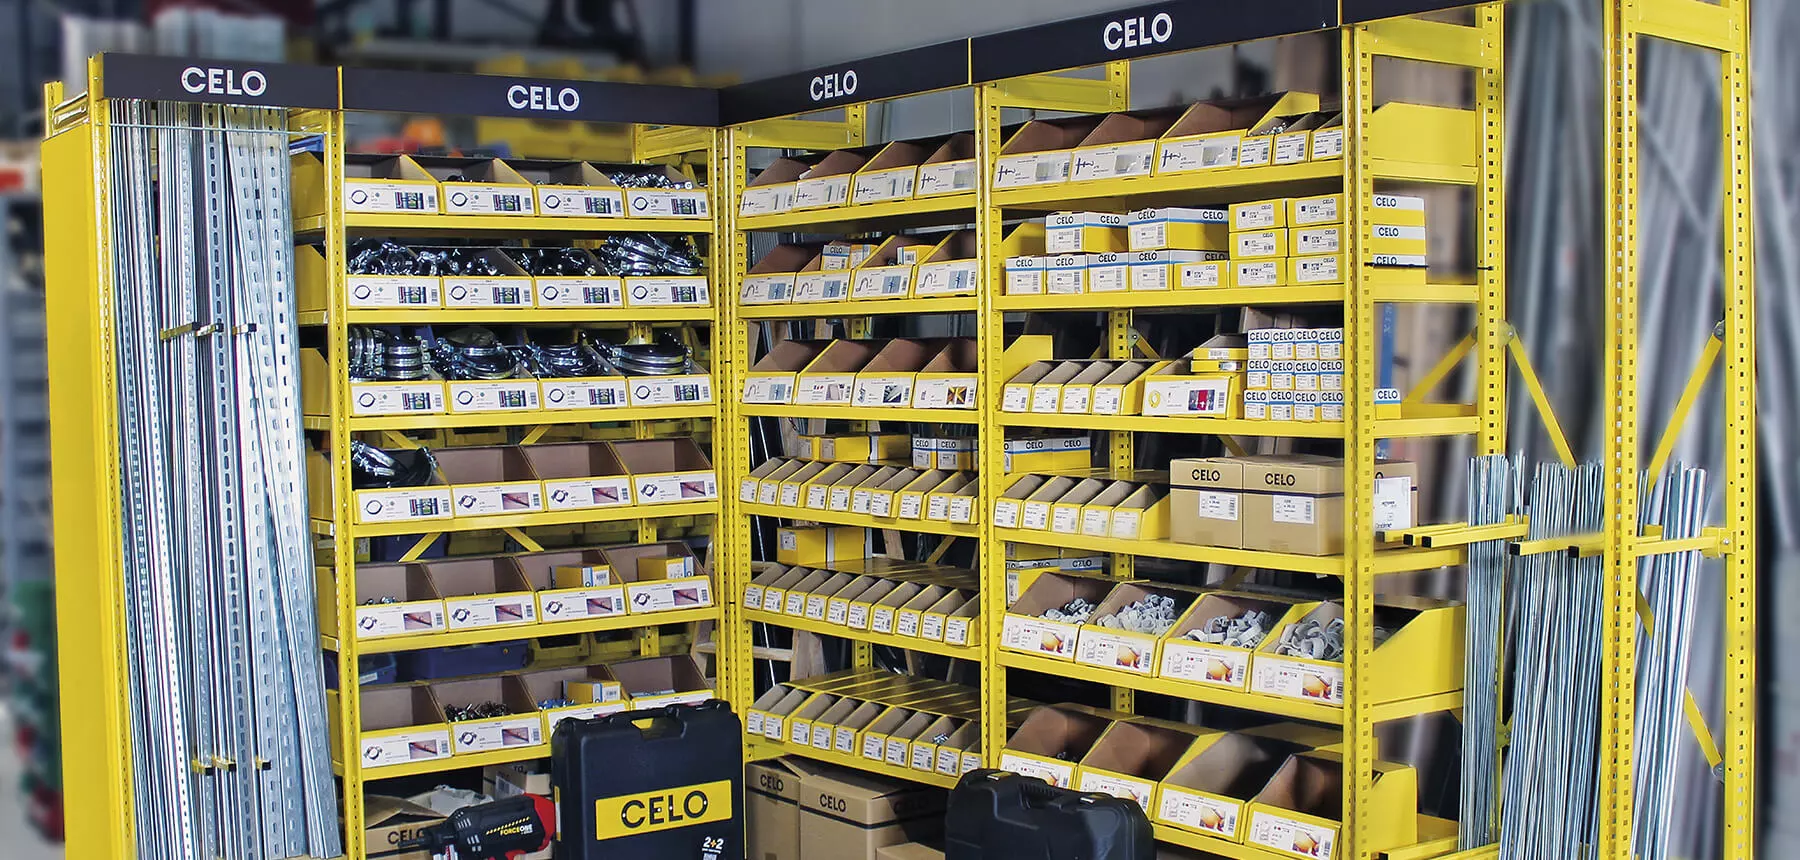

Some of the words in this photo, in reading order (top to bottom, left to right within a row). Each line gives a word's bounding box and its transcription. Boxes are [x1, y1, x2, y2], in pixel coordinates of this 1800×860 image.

[1103, 12, 1173, 51] CELO
[181, 66, 267, 97] CELO
[810, 70, 858, 101] CELO
[507, 84, 580, 112] CELO
[1376, 197, 1397, 207] CELO
[1137, 210, 1156, 220] CELO
[1202, 211, 1224, 220] CELO
[1056, 216, 1074, 225] CELO
[1100, 215, 1120, 225] CELO
[1379, 227, 1399, 237] CELO
[1098, 254, 1117, 262] CELO
[1138, 252, 1158, 261] CELO
[1205, 253, 1226, 261] CELO
[1376, 256, 1397, 265] CELO
[1015, 259, 1033, 268] CELO
[1055, 258, 1074, 266] CELO
[1249, 332, 1270, 341] CELO
[1273, 332, 1294, 341] CELO
[1296, 330, 1318, 340] CELO
[1319, 330, 1341, 340] CELO
[1248, 360, 1269, 369] CELO
[1272, 362, 1293, 371] CELO
[1295, 362, 1317, 371] CELO
[1320, 361, 1342, 370] CELO
[1245, 392, 1267, 401] CELO
[1270, 391, 1292, 400] CELO
[1295, 393, 1317, 402] CELO
[1321, 392, 1343, 401] CELO
[1377, 390, 1398, 399] CELO
[915, 440, 929, 448] CELO
[941, 441, 956, 449] CELO
[1025, 440, 1044, 449] CELO
[1063, 440, 1082, 448] CELO
[1191, 469, 1221, 482] CELO
[1264, 473, 1296, 486] CELO
[1072, 559, 1092, 568] CELO
[760, 774, 784, 793] CELO
[819, 793, 847, 812] CELO
[621, 790, 708, 829] CELO
[703, 835, 724, 850] 2+2
